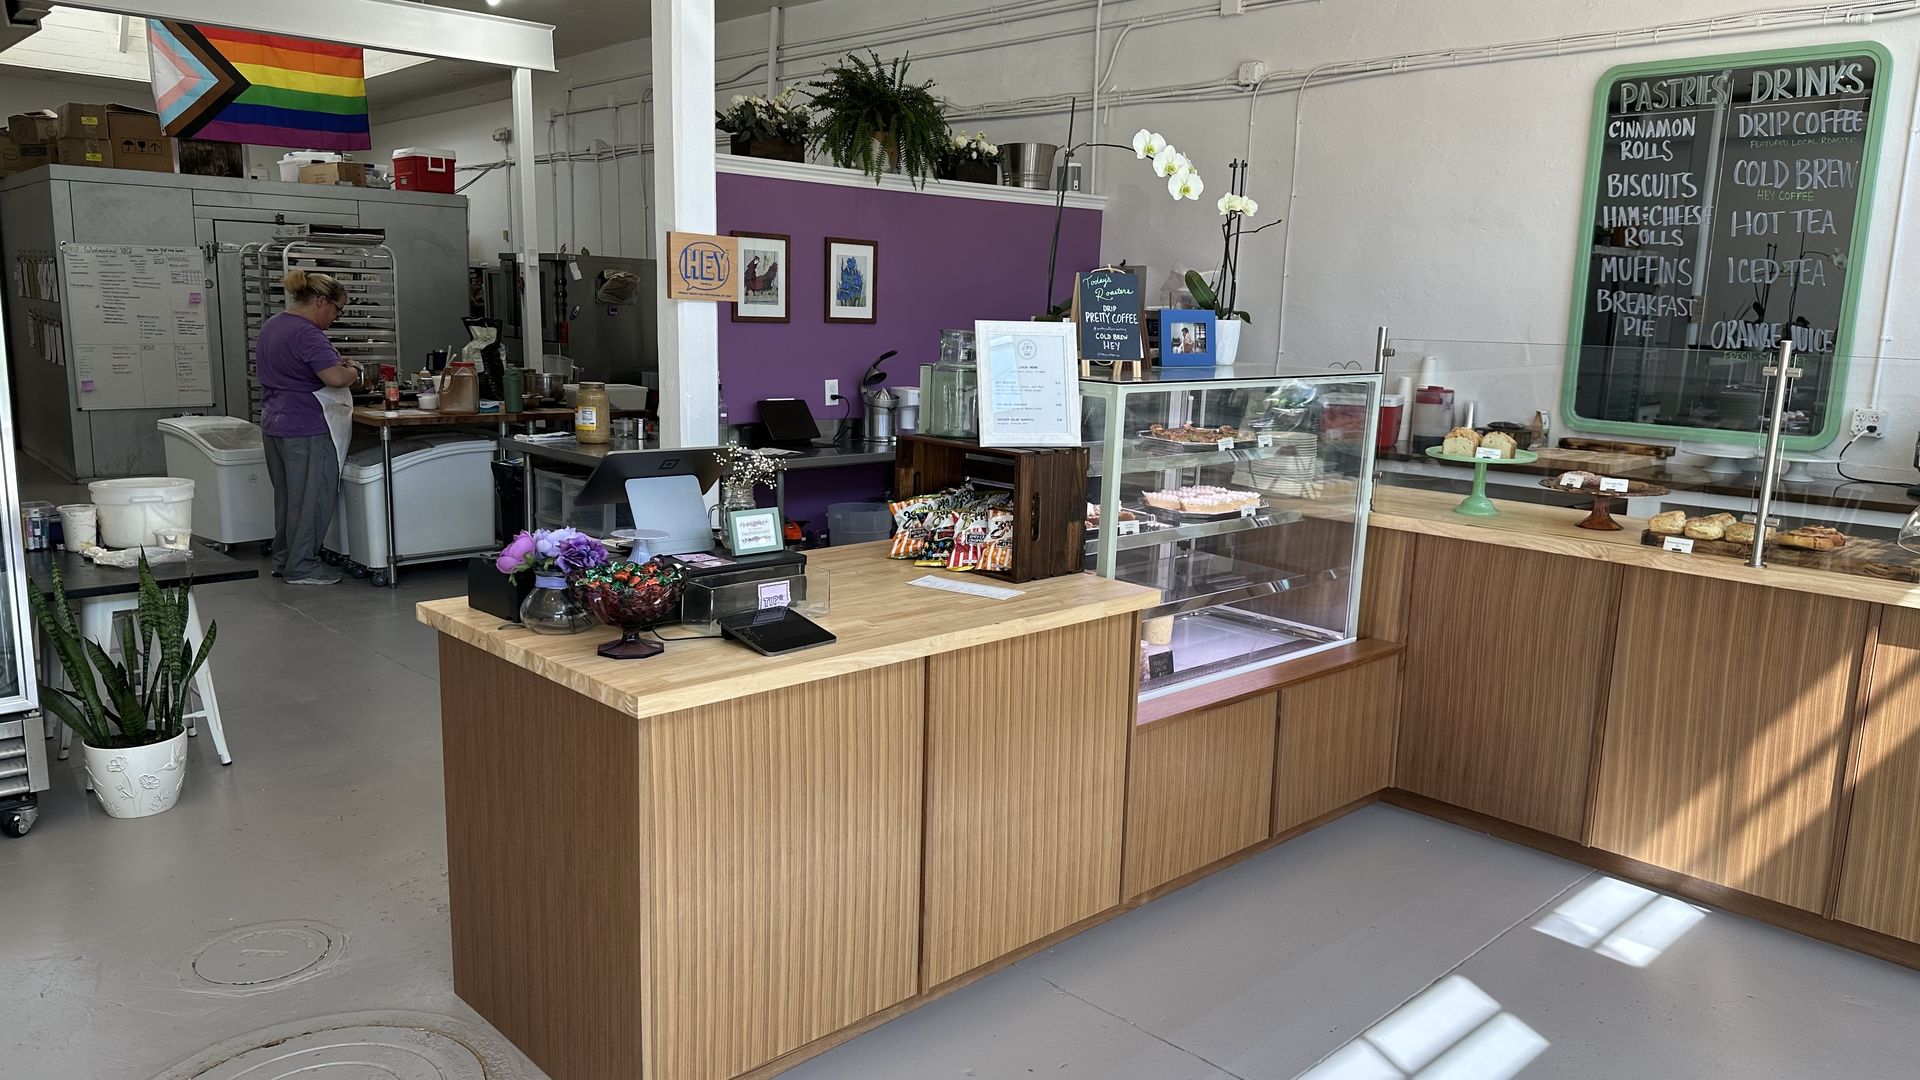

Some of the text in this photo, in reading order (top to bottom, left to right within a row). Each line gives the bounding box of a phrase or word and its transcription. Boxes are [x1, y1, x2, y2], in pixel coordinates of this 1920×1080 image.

[1621, 75, 1727, 114] PASTRIES
[1751, 63, 1865, 104] DRINKS
[1608, 116, 1696, 138] CINNAMON
[1739, 109, 1863, 138] DRIP COFFEE
[1620, 140, 1674, 161] ROLLS
[1791, 138, 1817, 147] LOCAL
[1607, 172, 1698, 199] BISCUITS
[1733, 158, 1859, 190] COLD BREW
[1756, 190, 1815, 202] HEY COFFEE
[1603, 206, 1640, 229] HAM
[1649, 204, 1714, 227] CHEESE
[1731, 208, 1837, 238] HOT TEA
[1624, 226, 1684, 247] ROLLS
[684, 247, 728, 281] HEY
[1601, 255, 1693, 286] MUFFINS
[1728, 257, 1826, 286] ICED TEA
[1082, 274, 1112, 289] Today's
[1095, 287, 1134, 302] Roasters
[1597, 288, 1699, 317] BREAKFAST
[1085, 311, 1139, 325] PRETTY COFFEE
[1102, 304, 1117, 312] DRIP
[1095, 332, 1111, 340] COLD
[1622, 315, 1656, 337] PIE
[1710, 319, 1835, 353] ORANGE JUICE
[1103, 340, 1120, 351] HEY
